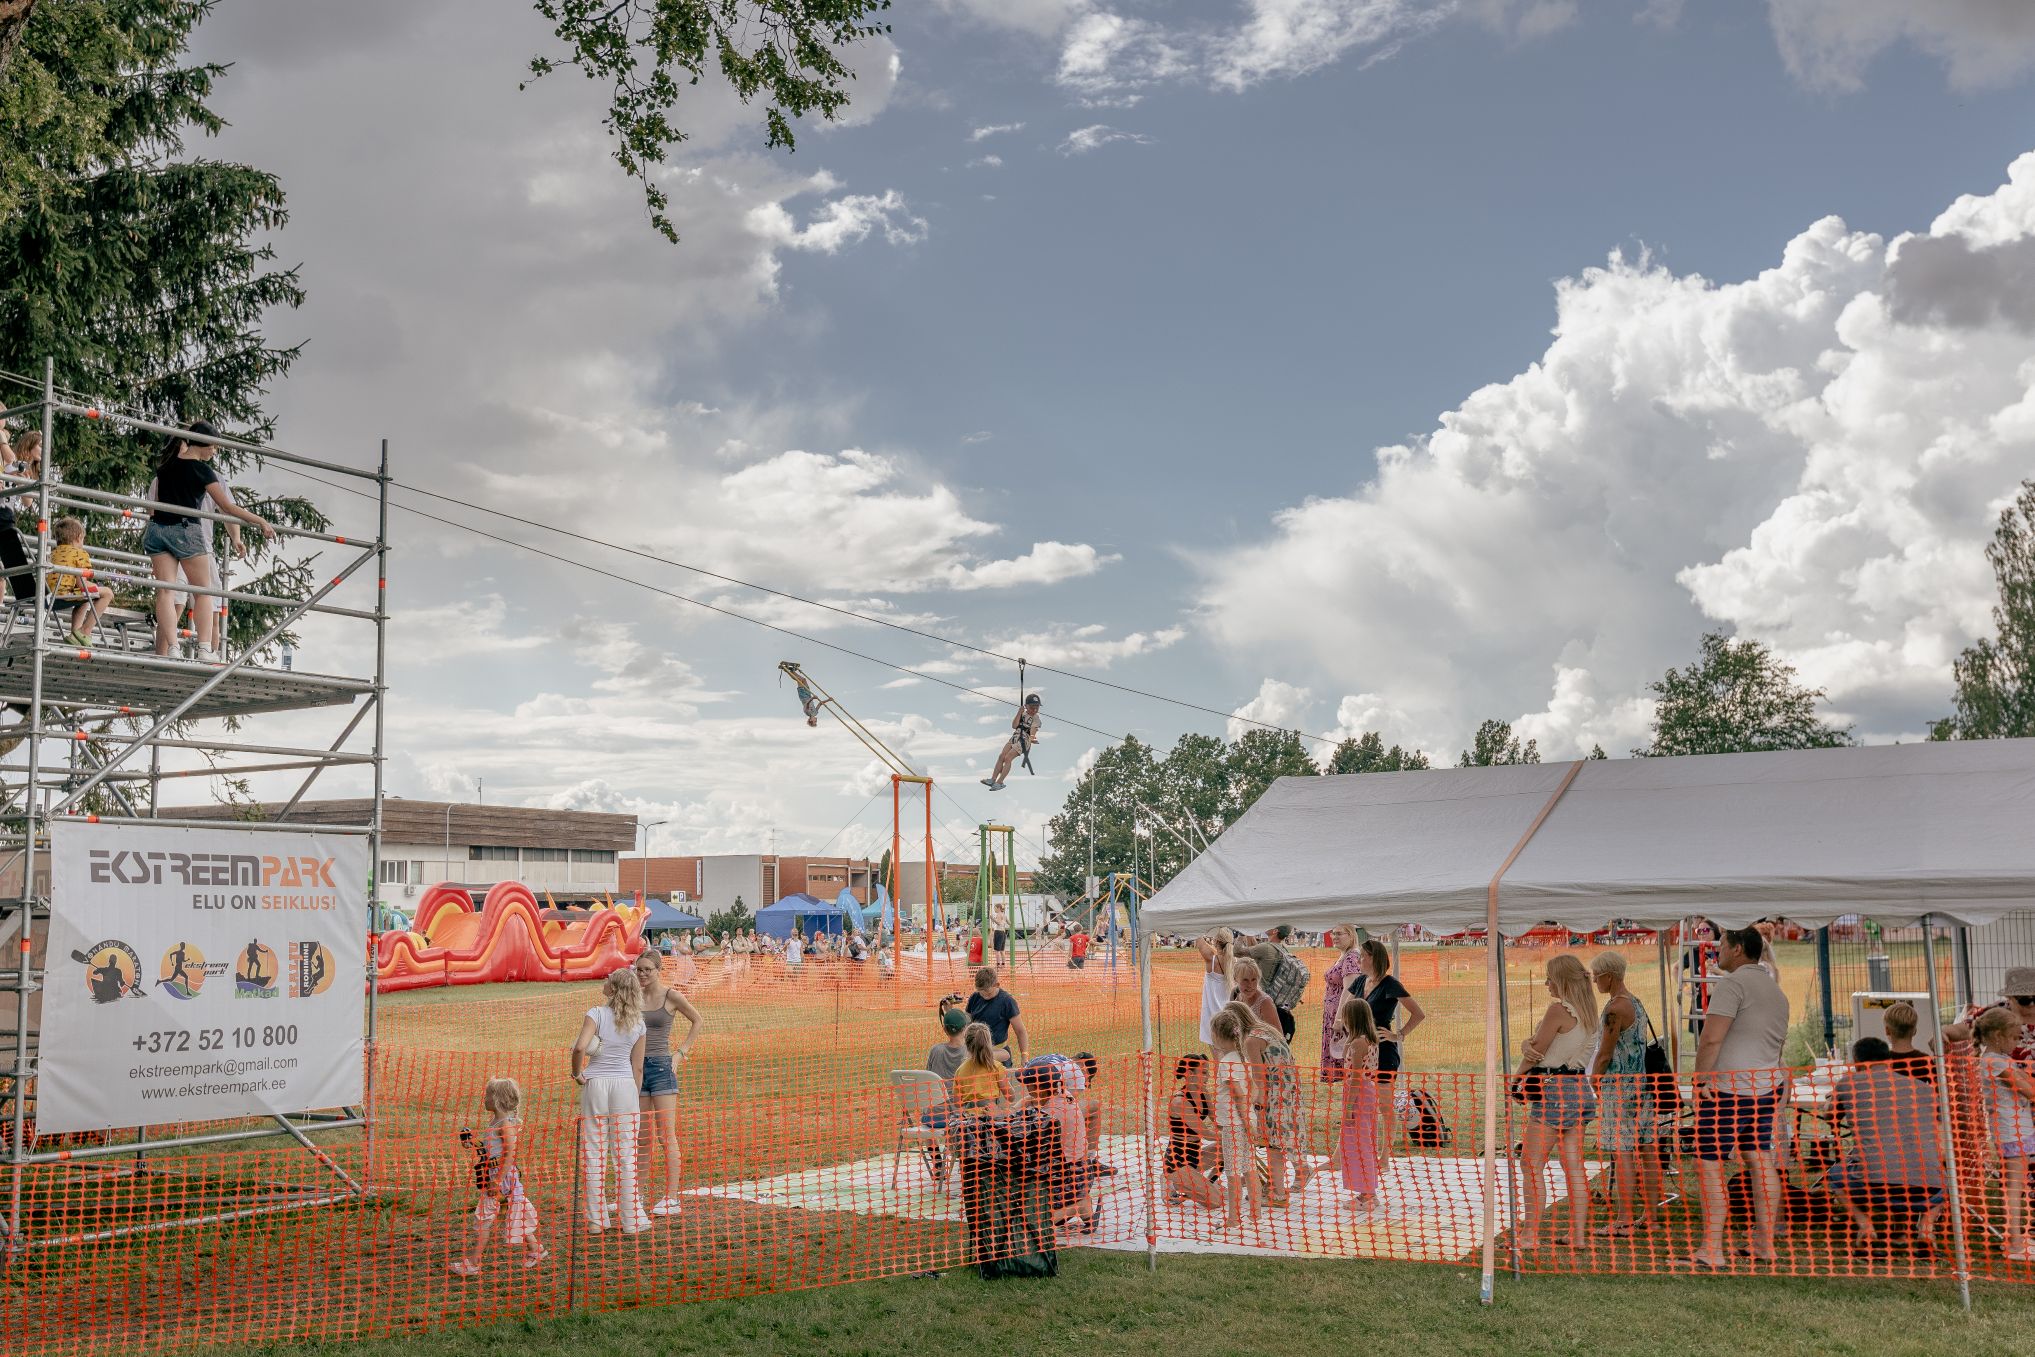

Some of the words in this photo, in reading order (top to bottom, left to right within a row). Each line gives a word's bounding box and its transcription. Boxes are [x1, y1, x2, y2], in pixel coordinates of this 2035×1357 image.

[192, 894, 226, 910] ELU
[230, 894, 256, 910] ON
[261, 895, 337, 911] SEIKLUS!
[203, 967, 226, 977] park
[288, 940, 304, 999] KALJU
[234, 986, 280, 999] Matkad
[132, 1030, 191, 1053] +372
[198, 1028, 224, 1051] 52
[232, 1026, 256, 1049] 10
[262, 1024, 298, 1047] 800
[129, 1057, 298, 1079] ekstreempark@gmail.com
[141, 1078, 287, 1100] www.ekstreempark.ee
